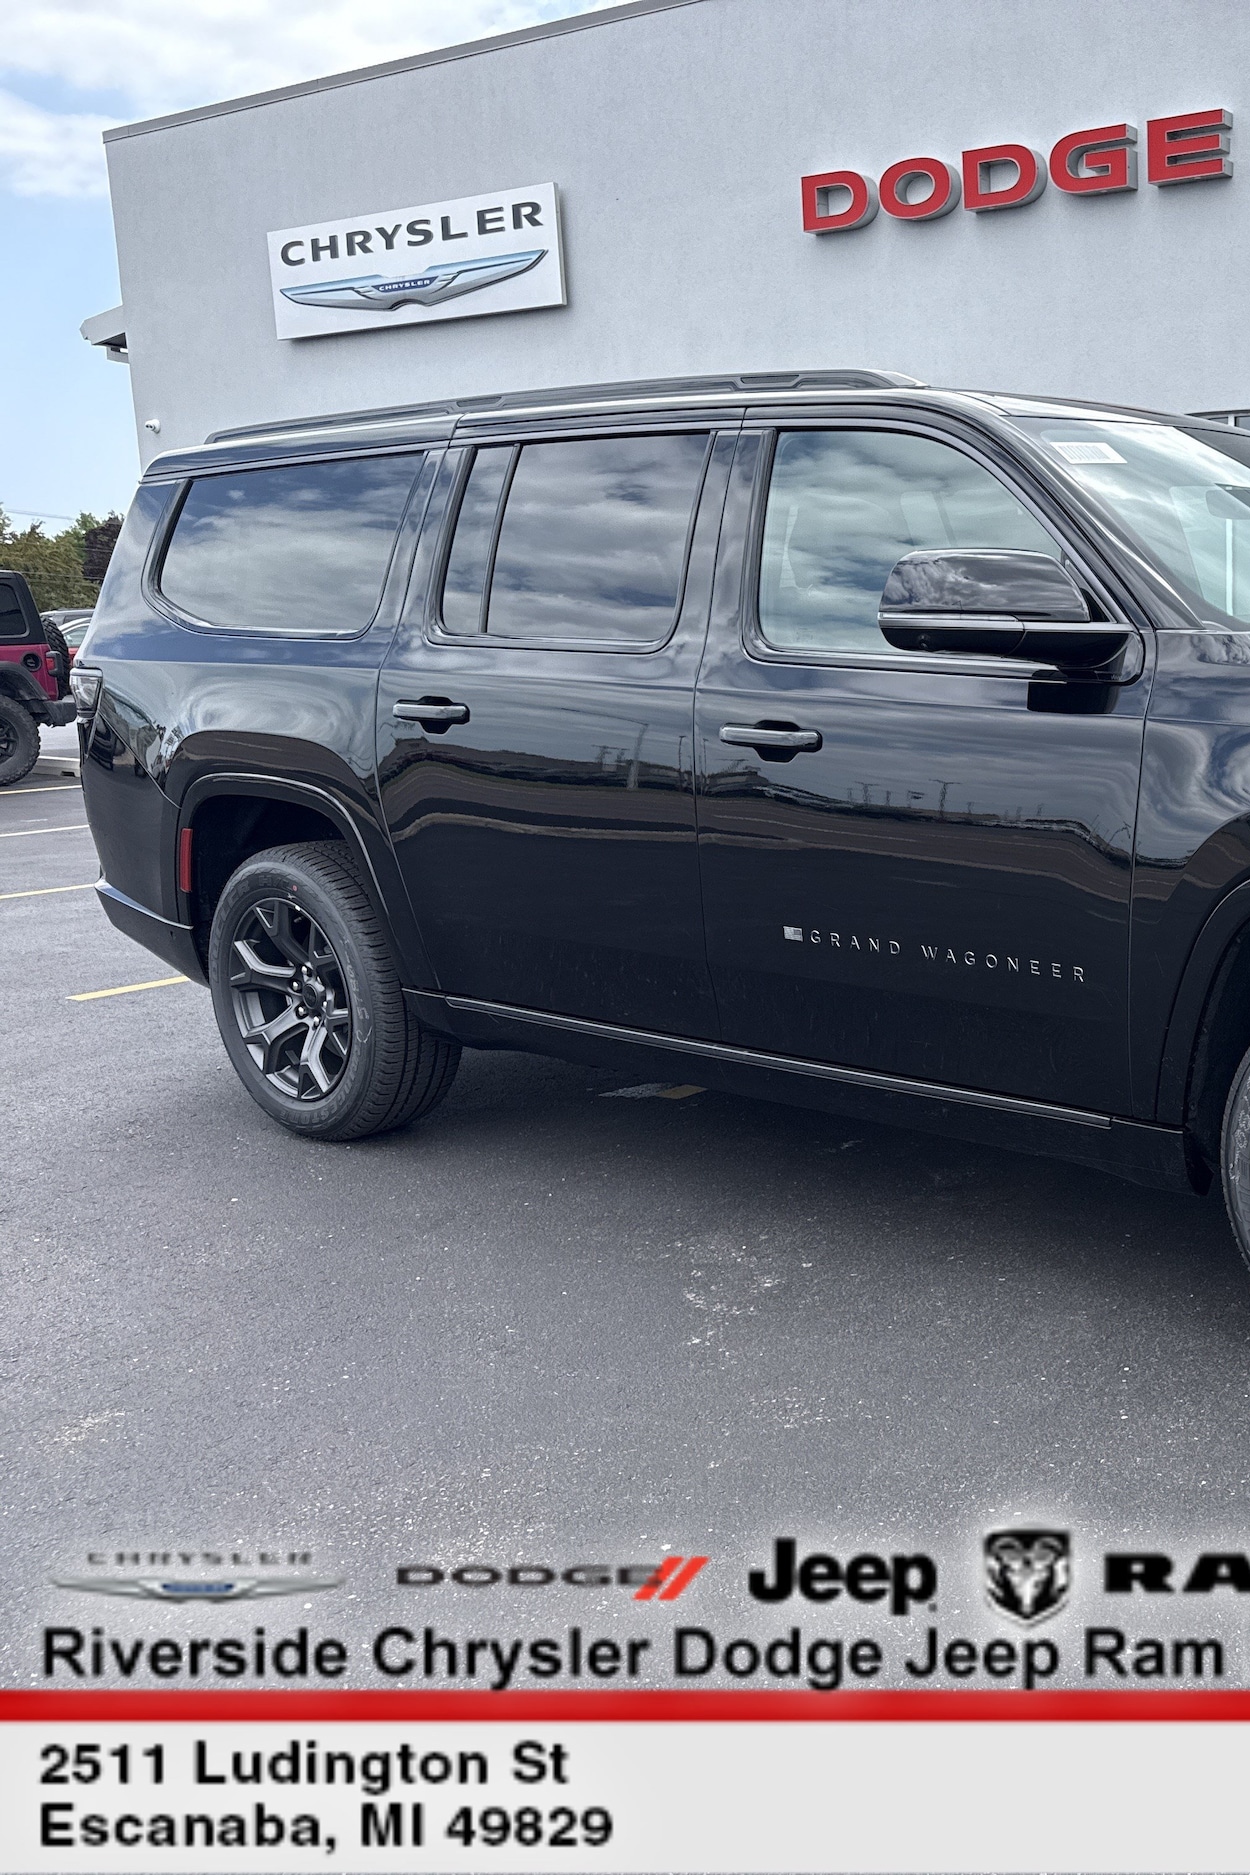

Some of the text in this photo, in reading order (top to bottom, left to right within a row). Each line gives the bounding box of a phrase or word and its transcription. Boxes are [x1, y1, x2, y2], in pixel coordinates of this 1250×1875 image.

[801, 108, 1230, 234] DODGE
[280, 201, 544, 267] CHRYSLER
[379, 279, 431, 292] CHRYSLER
[810, 929, 1087, 983] GRAND WAGONEER
